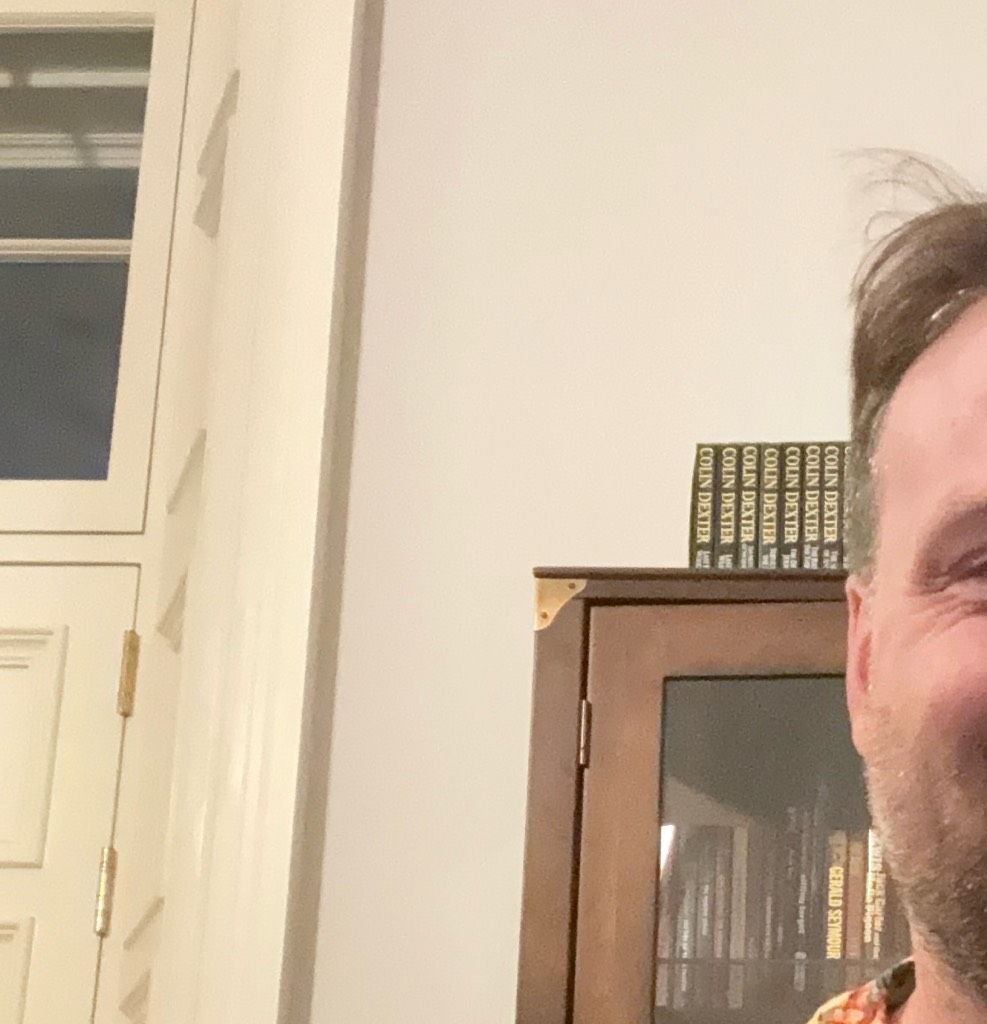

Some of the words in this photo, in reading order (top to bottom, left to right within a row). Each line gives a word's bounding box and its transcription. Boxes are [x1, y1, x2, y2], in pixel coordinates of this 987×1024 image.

[699, 448, 714, 488] COLIN
[722, 448, 737, 488] COLIN
[742, 446, 757, 487] COLIN
[764, 448, 779, 489] COLIN
[785, 447, 800, 488] COLIN
[805, 446, 820, 486] COLIN
[824, 446, 839, 486] COLIN
[697, 492, 712, 543] DEXTER
[720, 492, 735, 544] DEXTER
[741, 491, 756, 543] DEXTER
[763, 493, 778, 544] DEXTER
[784, 491, 799, 543] DEXTER
[804, 490, 819, 542] DEXTER
[823, 491, 838, 543] DEXTER
[828, 866, 844, 907] GERALD
[826, 909, 843, 959] SEYMOUR
